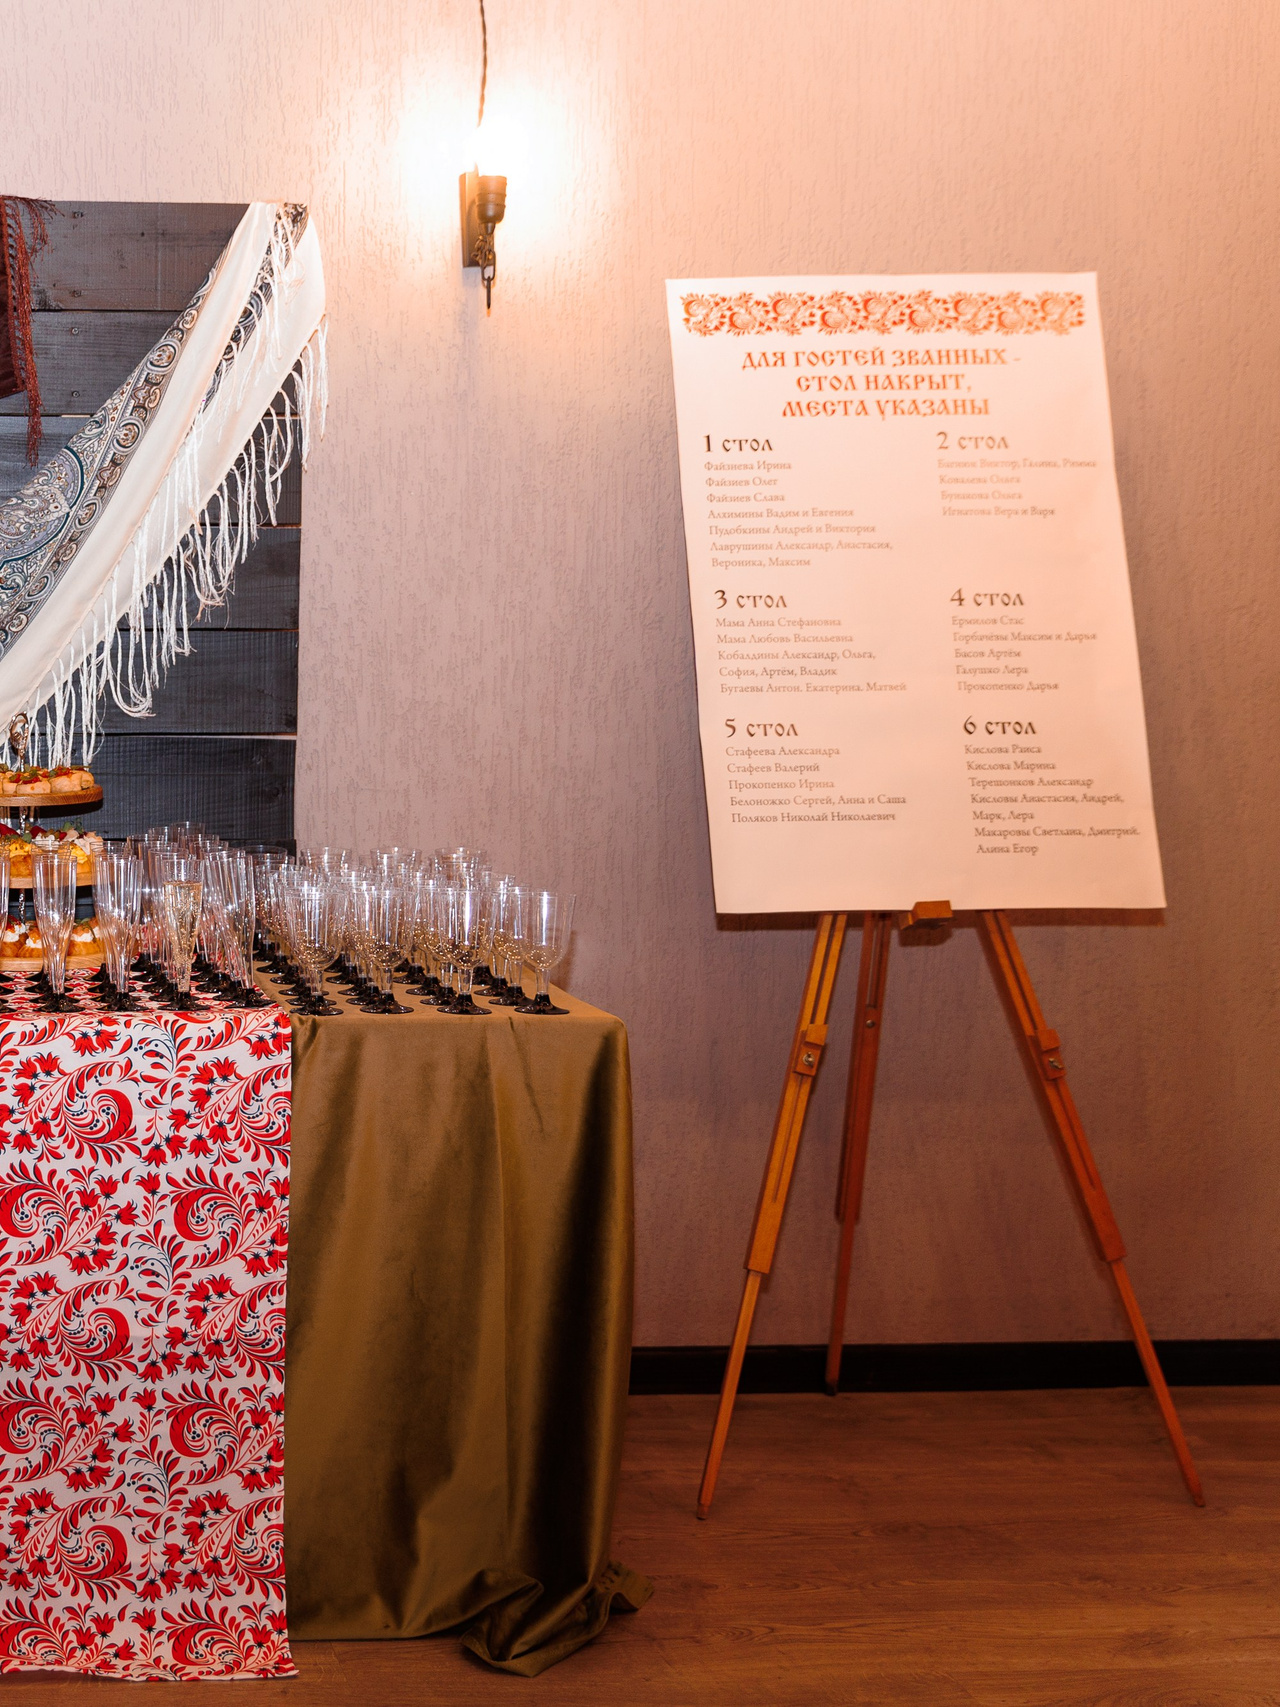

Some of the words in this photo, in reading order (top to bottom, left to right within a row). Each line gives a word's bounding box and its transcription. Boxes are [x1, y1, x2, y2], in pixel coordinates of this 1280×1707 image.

[742, 351, 786, 371] ДЛЯ
[795, 347, 884, 367] ГОСТЕЙ
[892, 348, 1007, 366] ЗВАННЫХ
[796, 374, 856, 392] СТОЛ
[864, 373, 972, 393] НАКРЫТ,
[782, 399, 869, 418] МЕСТА
[878, 398, 990, 421] УКАЗАНЫ
[704, 435, 712, 452] 1
[936, 432, 949, 450] 2
[754, 492, 785, 502] Слава
[766, 509, 800, 518] Вадим
[812, 508, 854, 517] Евгения
[773, 524, 813, 536] Андрей
[825, 524, 876, 534] Виктория
[776, 541, 833, 552] Александр,
[712, 558, 766, 570] Вероника,
[768, 557, 810, 567] Максим
[714, 590, 727, 609] 3
[950, 588, 965, 606] 4
[716, 619, 744, 627] Мама
[747, 618, 774, 627] Анна
[778, 617, 841, 628] Стефановна
[1000, 616, 1024, 625] Стас
[717, 634, 746, 644] Мама
[749, 634, 790, 643] Любовь
[794, 634, 853, 643] Васильевна
[1011, 632, 1053, 641] Максим
[782, 650, 839, 661] Александр,
[842, 649, 875, 660] Ольга,
[955, 649, 984, 658] Басов
[719, 667, 758, 678] София,
[761, 667, 797, 678] Артём,
[800, 667, 837, 676] Владик
[1003, 665, 1028, 676] Лера
[720, 684, 763, 695] Бугаевы
[866, 682, 907, 691] Матвей
[725, 718, 736, 738] 5
[963, 715, 976, 735] 6
[726, 747, 775, 758] Стафеева
[778, 746, 840, 757] Александра
[964, 745, 1009, 754] Кислова
[1012, 744, 1042, 753] Раиса
[727, 763, 772, 774] Стафеев
[775, 763, 820, 774] Валерий
[966, 761, 1010, 770] Кислова
[1013, 761, 1055, 772] Марина
[728, 780, 796, 791] Прокопенко
[799, 779, 835, 791] Ирина
[730, 797, 790, 806] Белоножко
[793, 796, 835, 808] Сергей,
[838, 795, 865, 804] Анна
[877, 794, 906, 804] Саша
[732, 813, 778, 823] Поляков
[781, 813, 828, 822] Николай
[831, 812, 895, 821] Николаевич
[977, 845, 1010, 854] Алина
[1013, 844, 1039, 855] Егор
